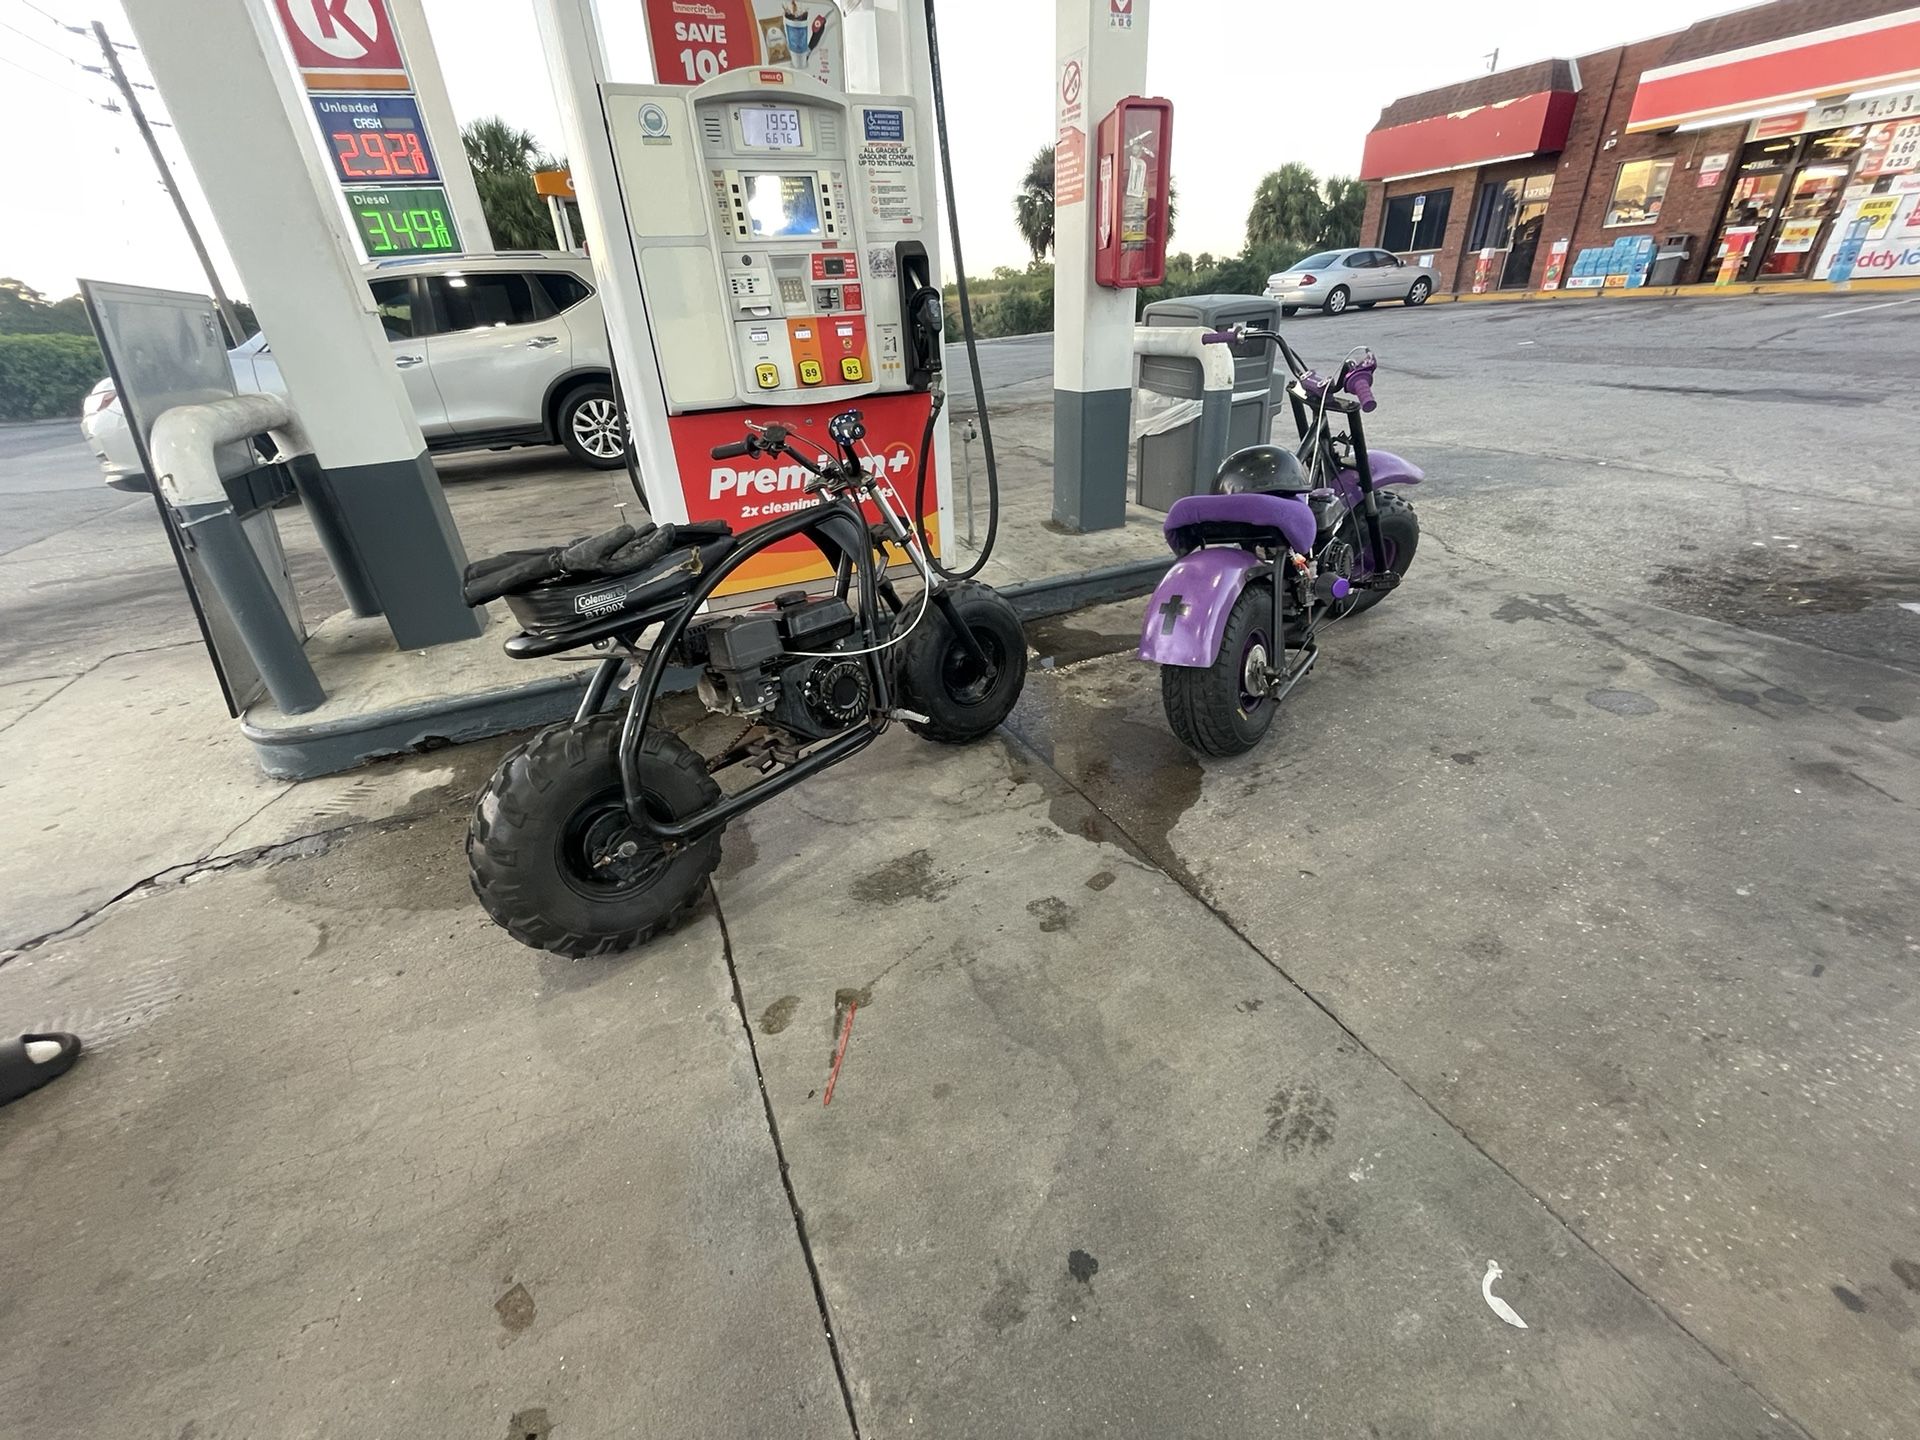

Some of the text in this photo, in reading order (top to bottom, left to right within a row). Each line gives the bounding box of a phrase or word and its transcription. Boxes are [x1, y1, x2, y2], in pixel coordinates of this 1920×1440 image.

[675, 21, 728, 44] SAVE
[680, 48, 728, 81] 10¢
[320, 102, 379, 113] Unleaded
[353, 118, 383, 129] CASH
[332, 133, 415, 176] 2.92
[353, 195, 390, 204] Diesel
[361, 211, 439, 251] 3.49
[805, 368, 818, 377] 89
[846, 365, 859, 375] 93
[741, 505, 759, 518] 2x
[578, 591, 616, 607] Coleman
[585, 601, 625, 619] BT200X
